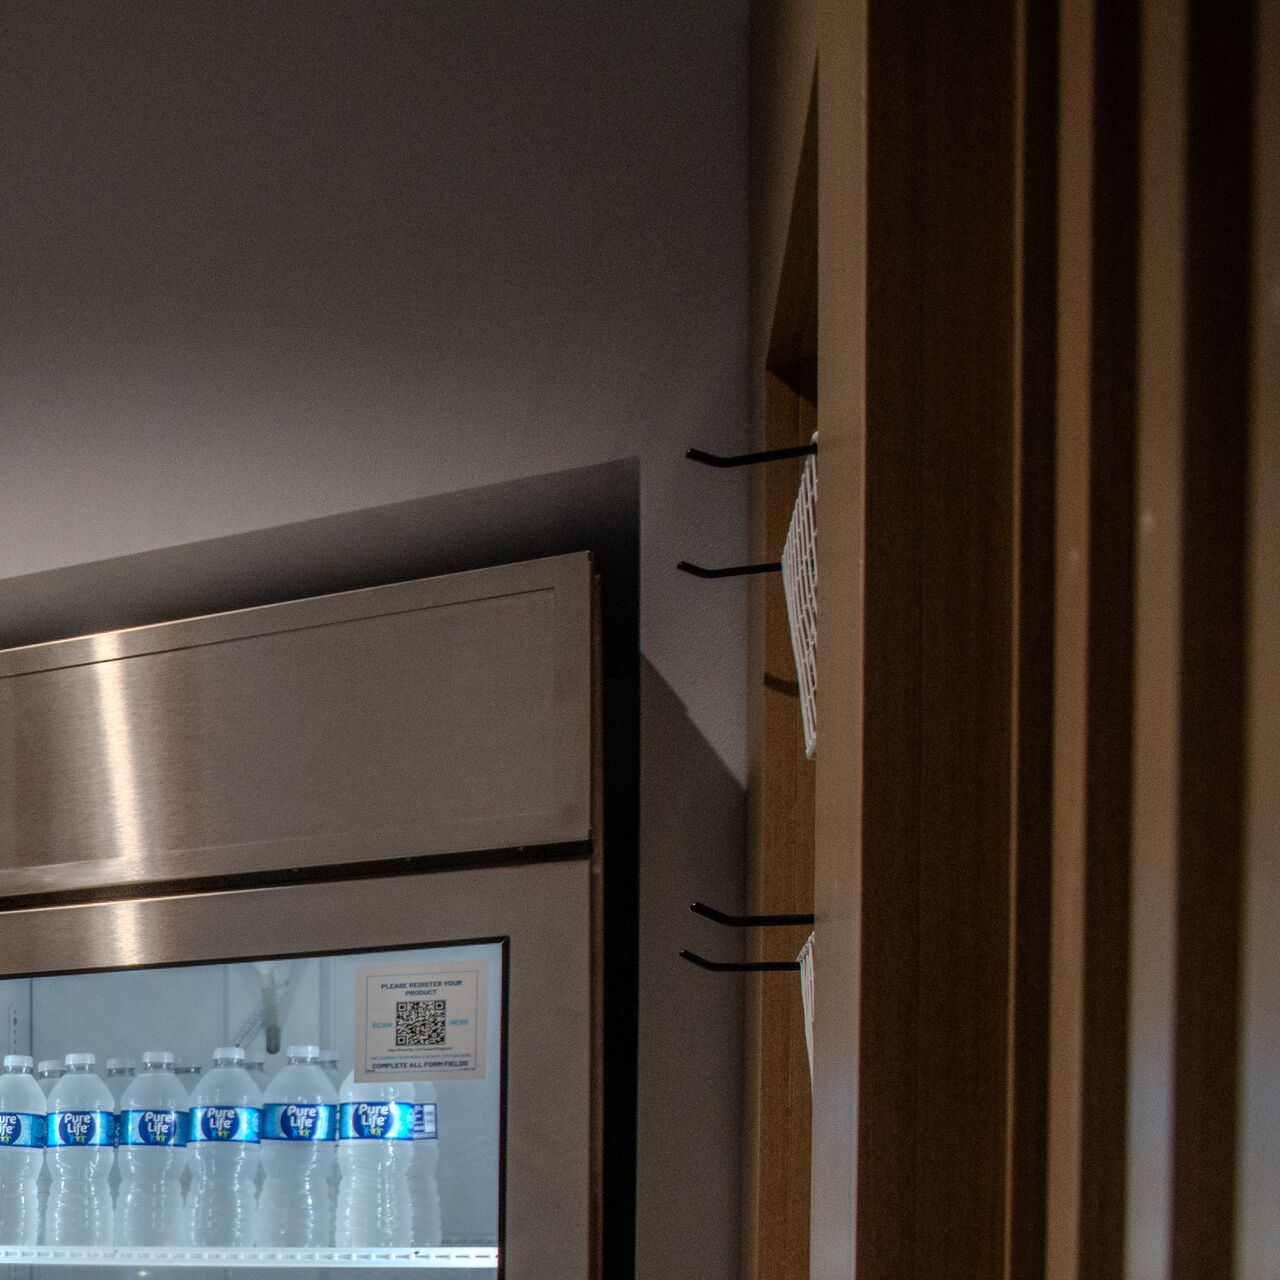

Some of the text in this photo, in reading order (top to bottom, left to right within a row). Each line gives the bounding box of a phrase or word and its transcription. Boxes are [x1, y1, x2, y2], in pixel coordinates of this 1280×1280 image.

[207, 1107, 235, 1120] Pure
[287, 1106, 317, 1118] Pure
[358, 1104, 389, 1116] Pure
[64, 1113, 91, 1125] Pure
[145, 1111, 173, 1123] Pure
[290, 1115, 313, 1129] Life
[361, 1113, 386, 1127] Life
[67, 1123, 89, 1135] Life
[147, 1122, 170, 1134] Life
[209, 1117, 232, 1130] Life
